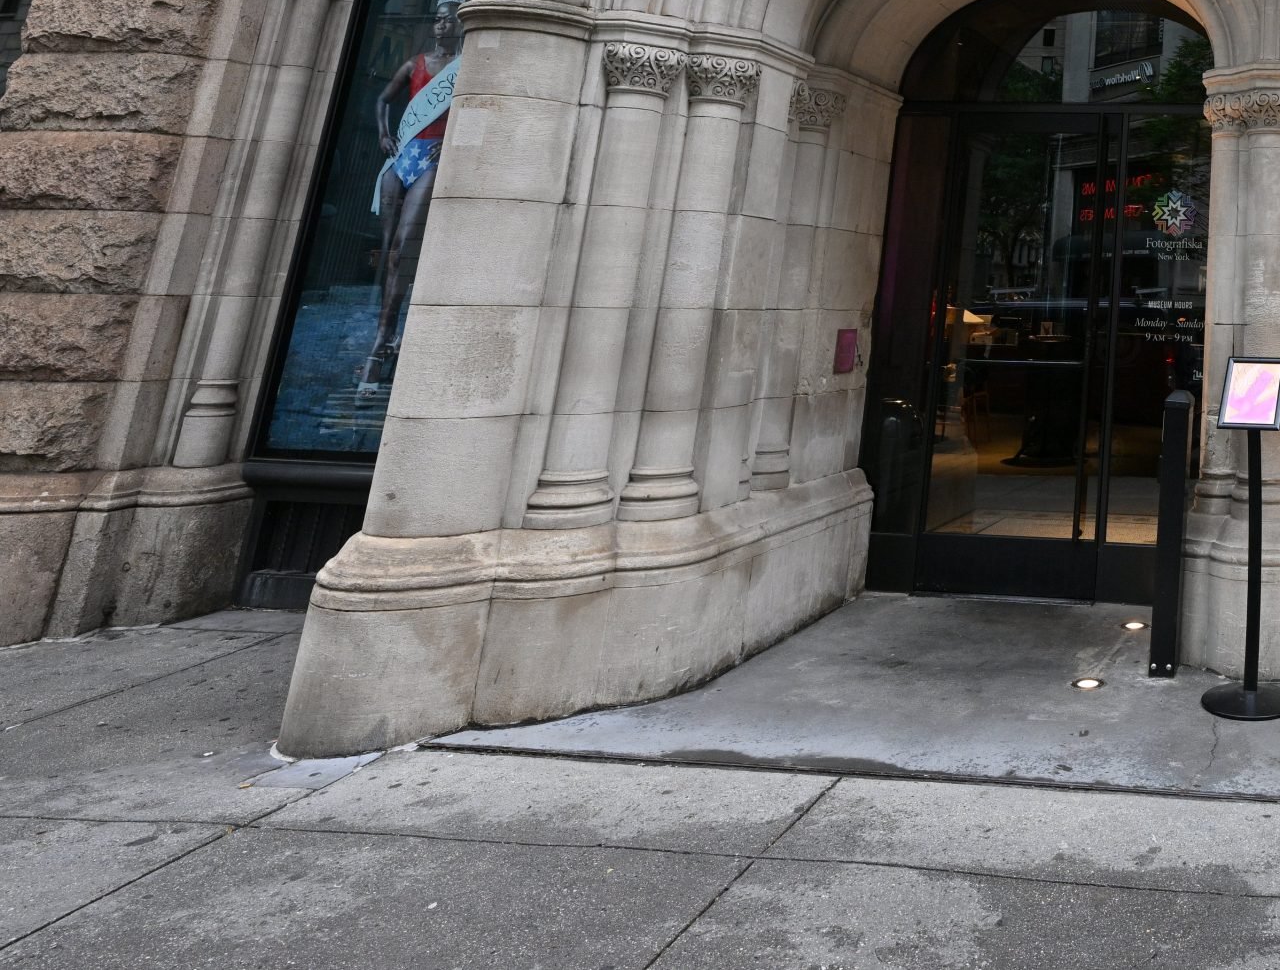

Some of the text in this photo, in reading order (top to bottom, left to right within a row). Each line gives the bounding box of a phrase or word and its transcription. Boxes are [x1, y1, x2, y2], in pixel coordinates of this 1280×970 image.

[1146, 238, 1203, 251] Fotografiska
[1157, 253, 1190, 261] New York
[1148, 300, 1193, 309] MUSEUM HOURS
[1134, 317, 1168, 330] Monday
[1175, 318, 1205, 330] Sunday
[1145, 333, 1151, 341] 9
[1152, 334, 1166, 342] AM
[1174, 333, 1180, 342] 9
